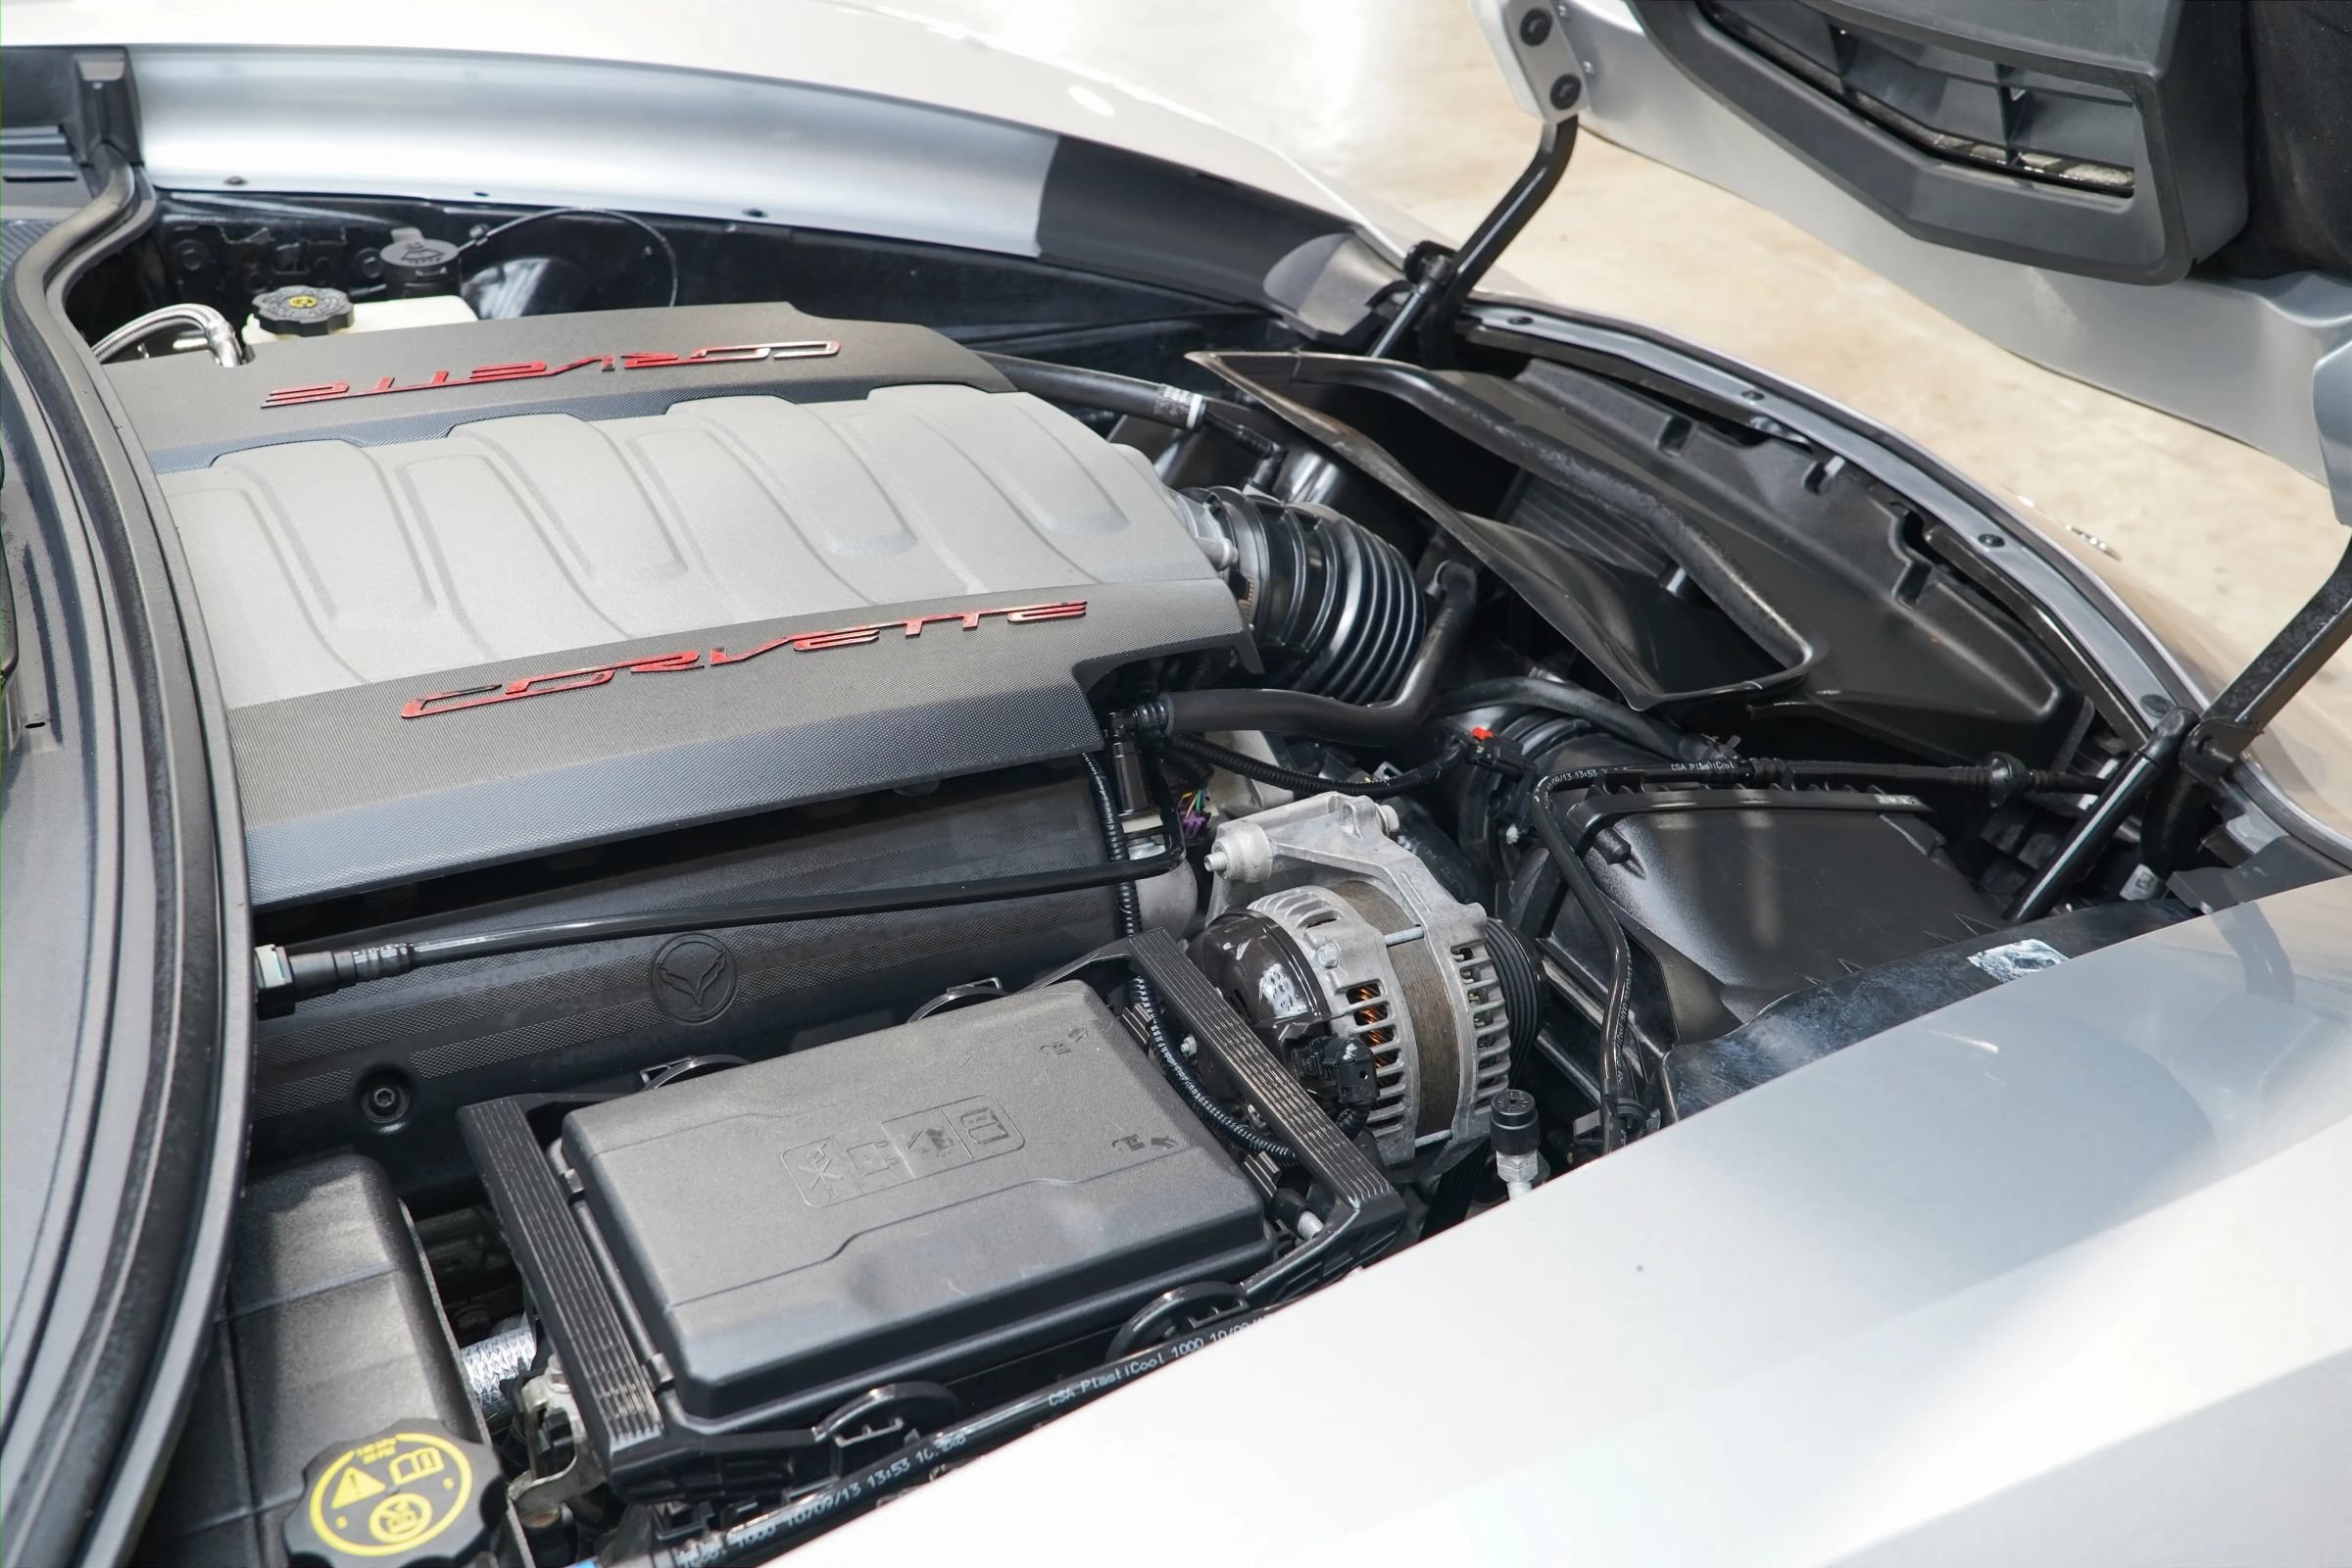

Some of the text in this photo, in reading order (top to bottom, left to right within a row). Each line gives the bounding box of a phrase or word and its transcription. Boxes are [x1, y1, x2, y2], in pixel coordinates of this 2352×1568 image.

[260, 340, 841, 410] CORVETTE
[400, 600, 1088, 719] CORVETTE
[1574, 769, 1598, 780] 13:53
[1049, 1389, 1076, 1406] CSA
[1080, 1353, 1165, 1394] PlastiCool
[1171, 1338, 1204, 1359] 1000
[865, 1457, 911, 1489] 13:53
